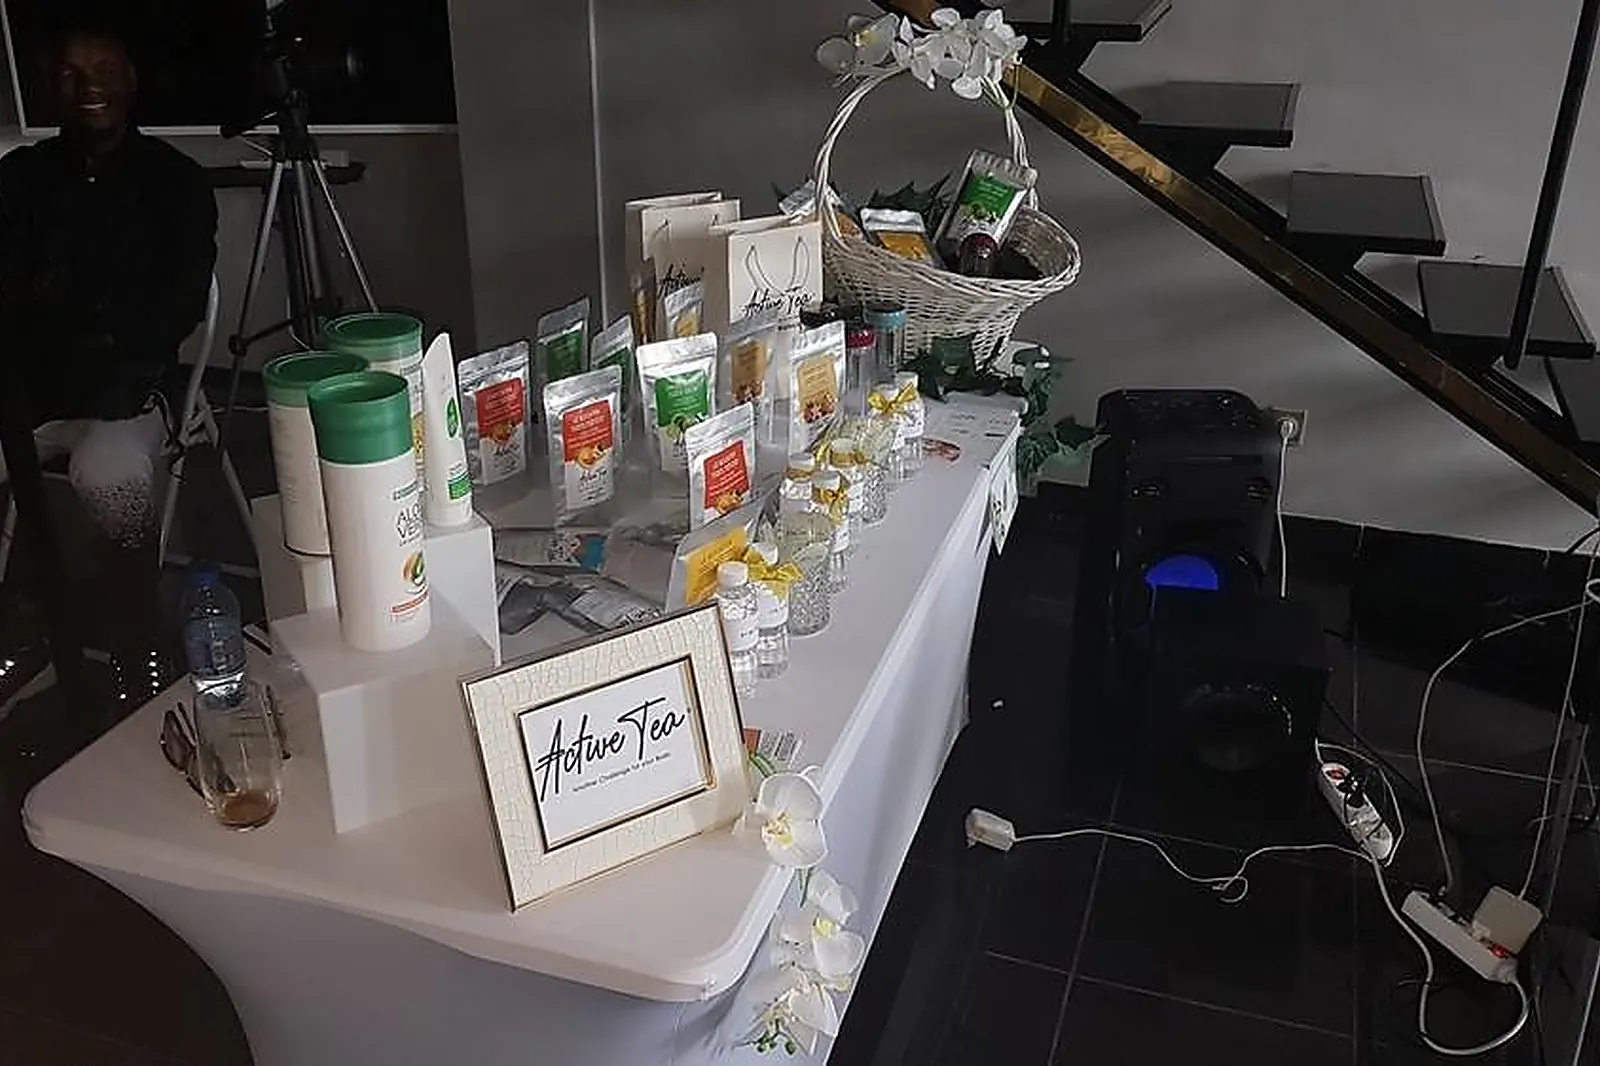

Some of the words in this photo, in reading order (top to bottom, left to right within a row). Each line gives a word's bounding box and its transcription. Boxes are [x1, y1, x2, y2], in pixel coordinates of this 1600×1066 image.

[742, 288, 785, 319] Active
[781, 286, 813, 314] Tea
[534, 714, 626, 803] Active
[617, 697, 686, 761] Tea
